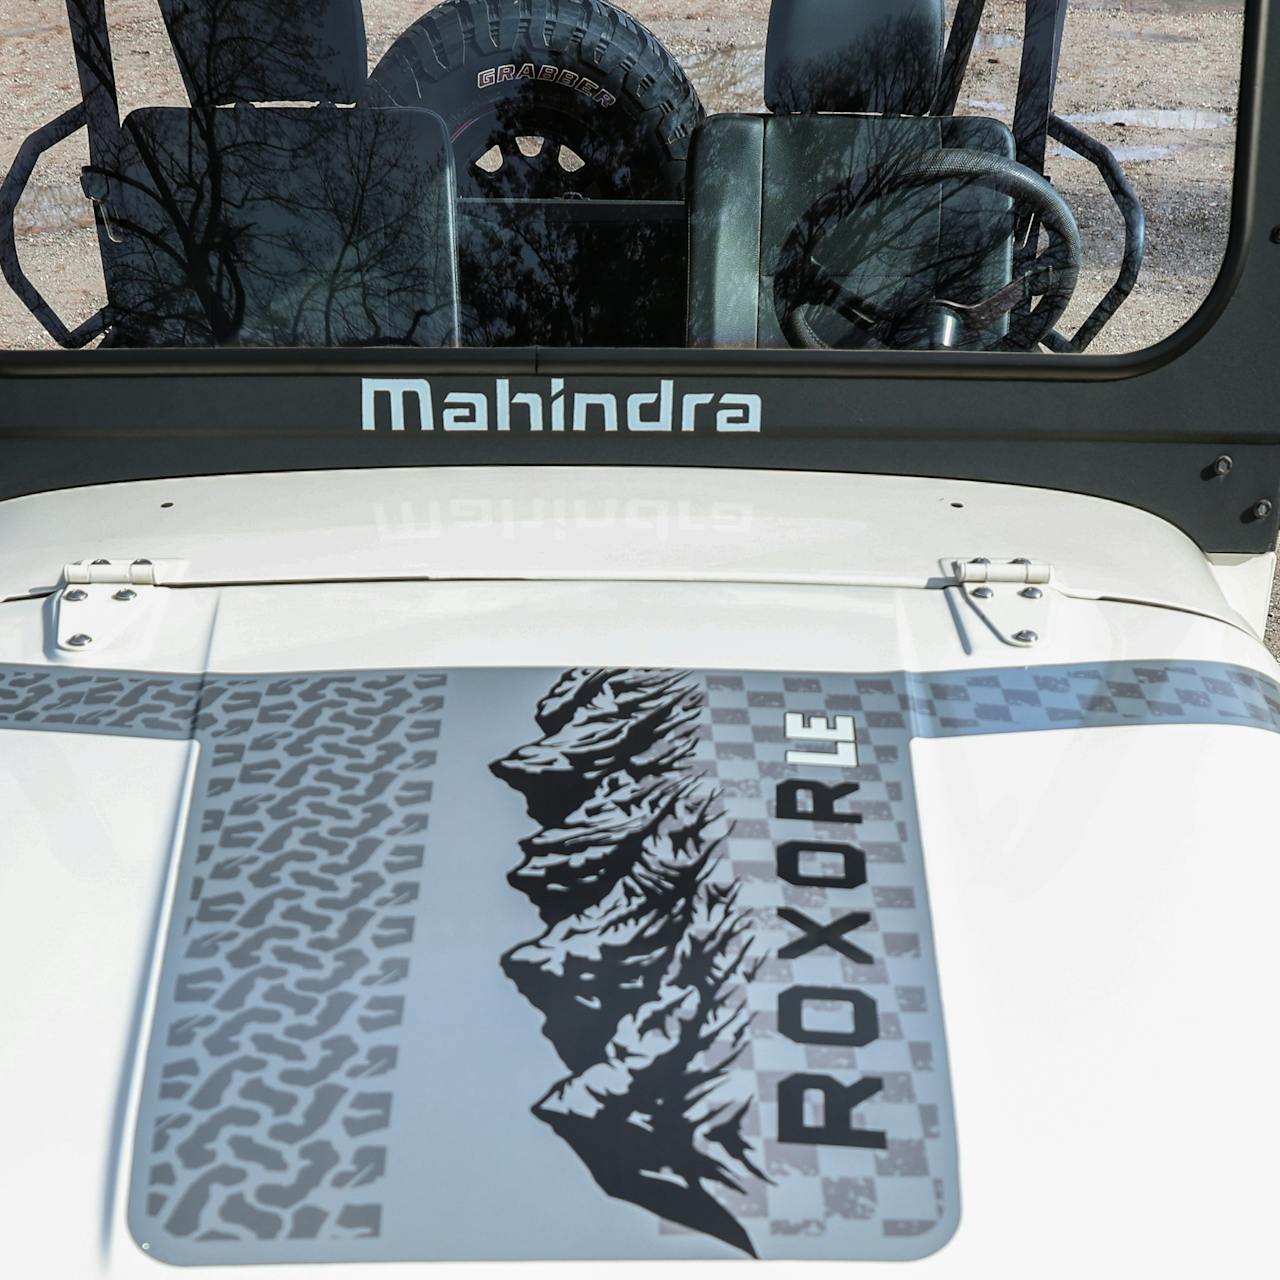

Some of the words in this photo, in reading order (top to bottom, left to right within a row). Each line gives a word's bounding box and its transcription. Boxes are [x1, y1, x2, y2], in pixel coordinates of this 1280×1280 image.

[477, 63, 617, 108] GRABBER
[361, 378, 762, 432] Mahindra
[783, 711, 859, 767] LE
[775, 778, 889, 1150] ROXOR
